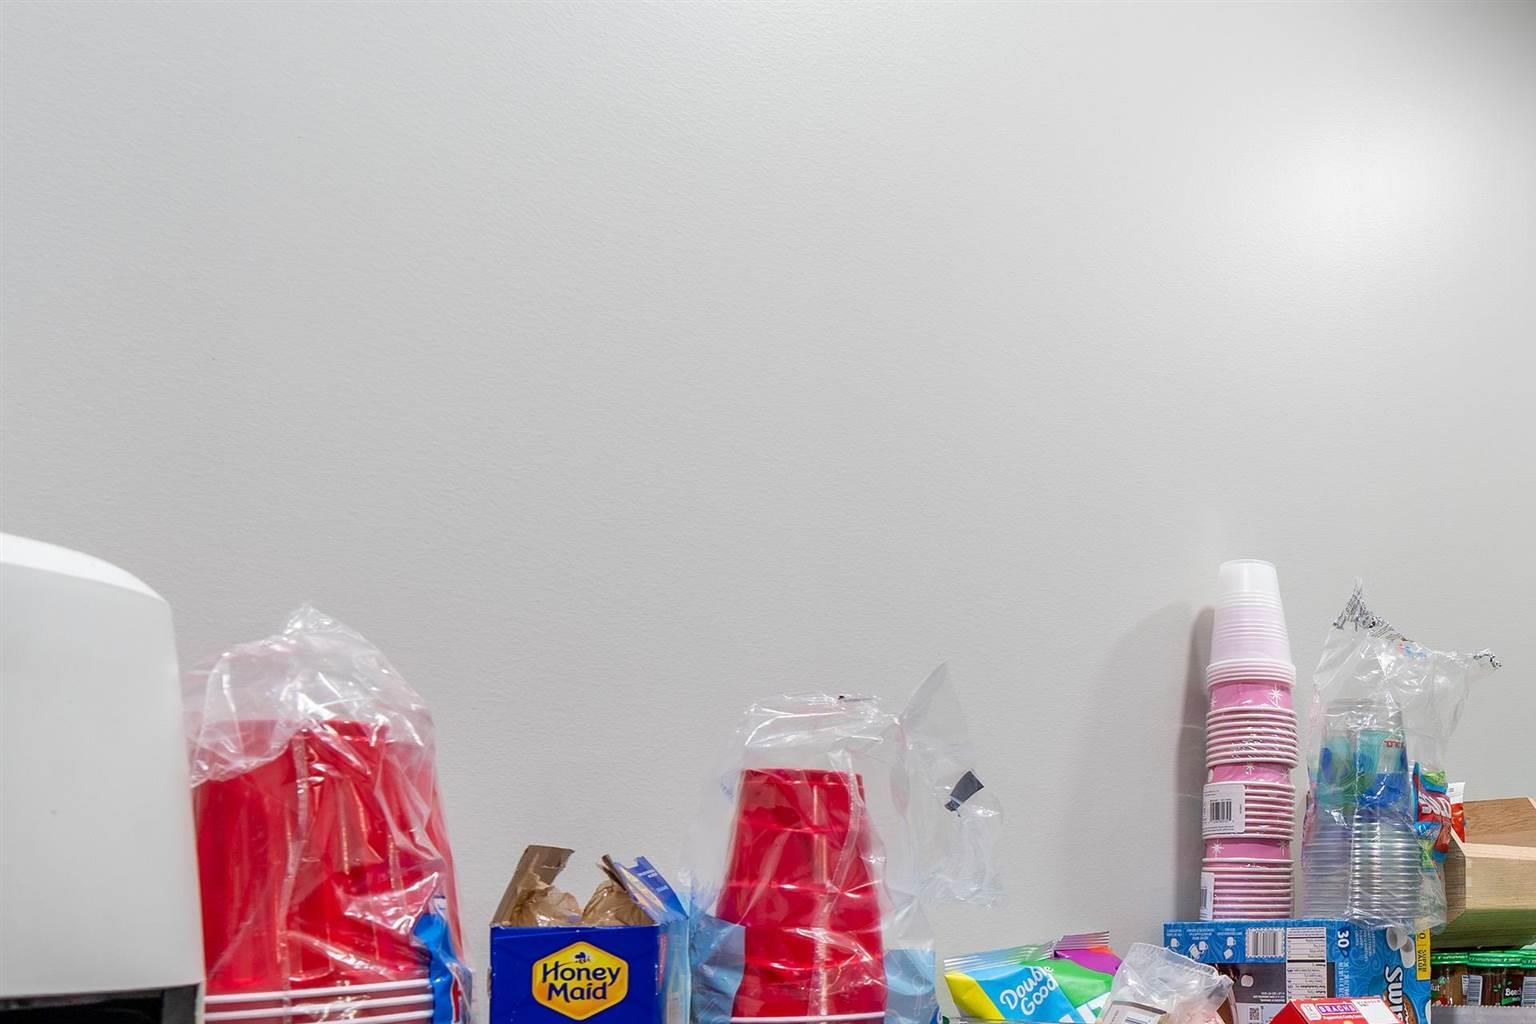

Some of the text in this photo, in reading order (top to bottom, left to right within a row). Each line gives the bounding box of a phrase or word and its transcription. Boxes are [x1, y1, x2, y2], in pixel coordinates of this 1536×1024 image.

[1337, 930, 1349, 948] 30
[540, 960, 621, 988] Honey
[999, 965, 1055, 1010] Double
[546, 979, 608, 1003] Maid
[1020, 975, 1059, 1016] Good
